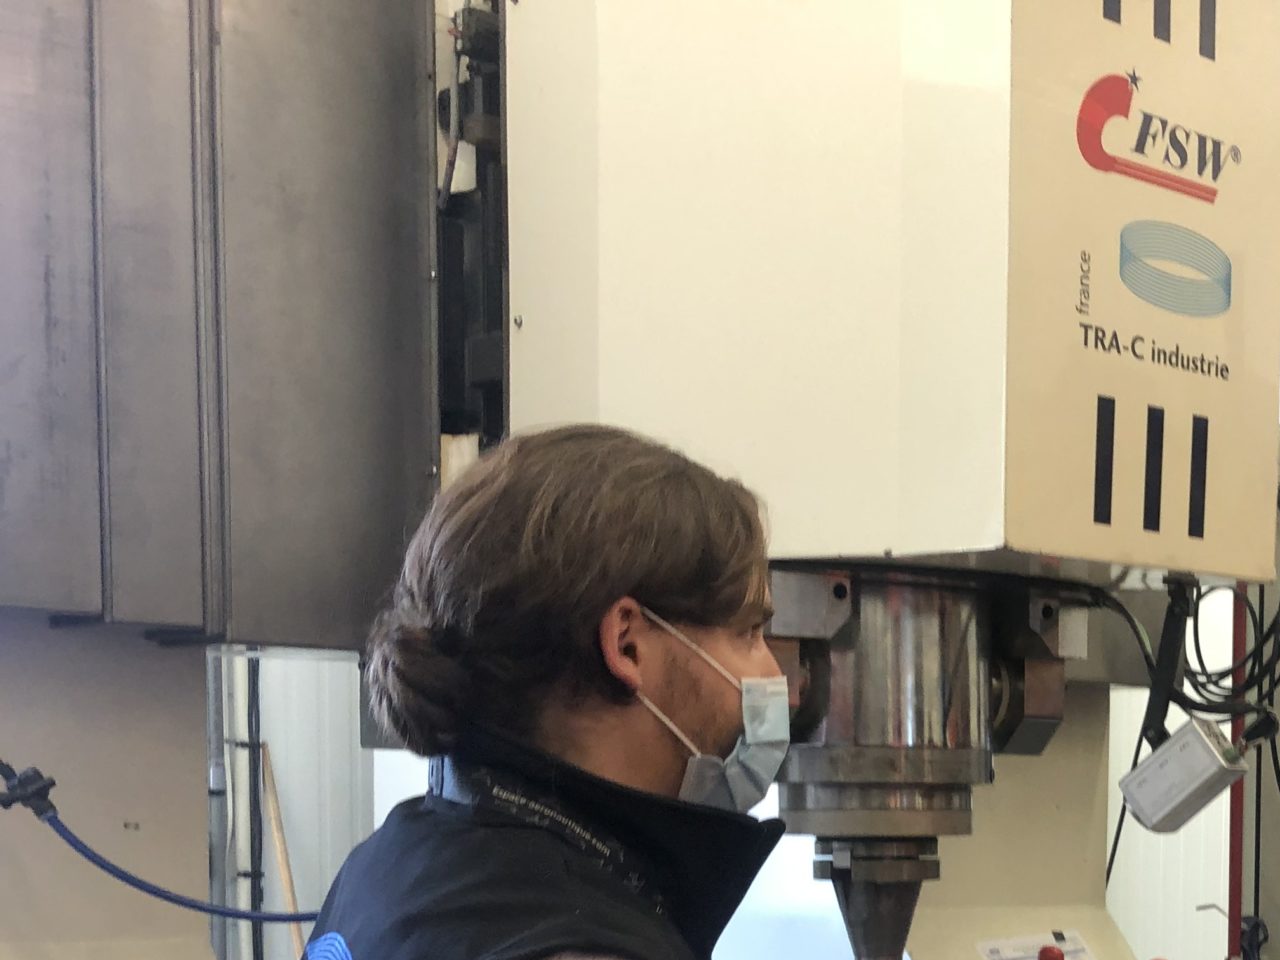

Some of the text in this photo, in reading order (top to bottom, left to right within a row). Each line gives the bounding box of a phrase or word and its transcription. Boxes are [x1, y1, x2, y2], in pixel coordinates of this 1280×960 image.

[1075, 250, 1091, 315] france
[1079, 322, 1230, 381] TRA-C industrie
